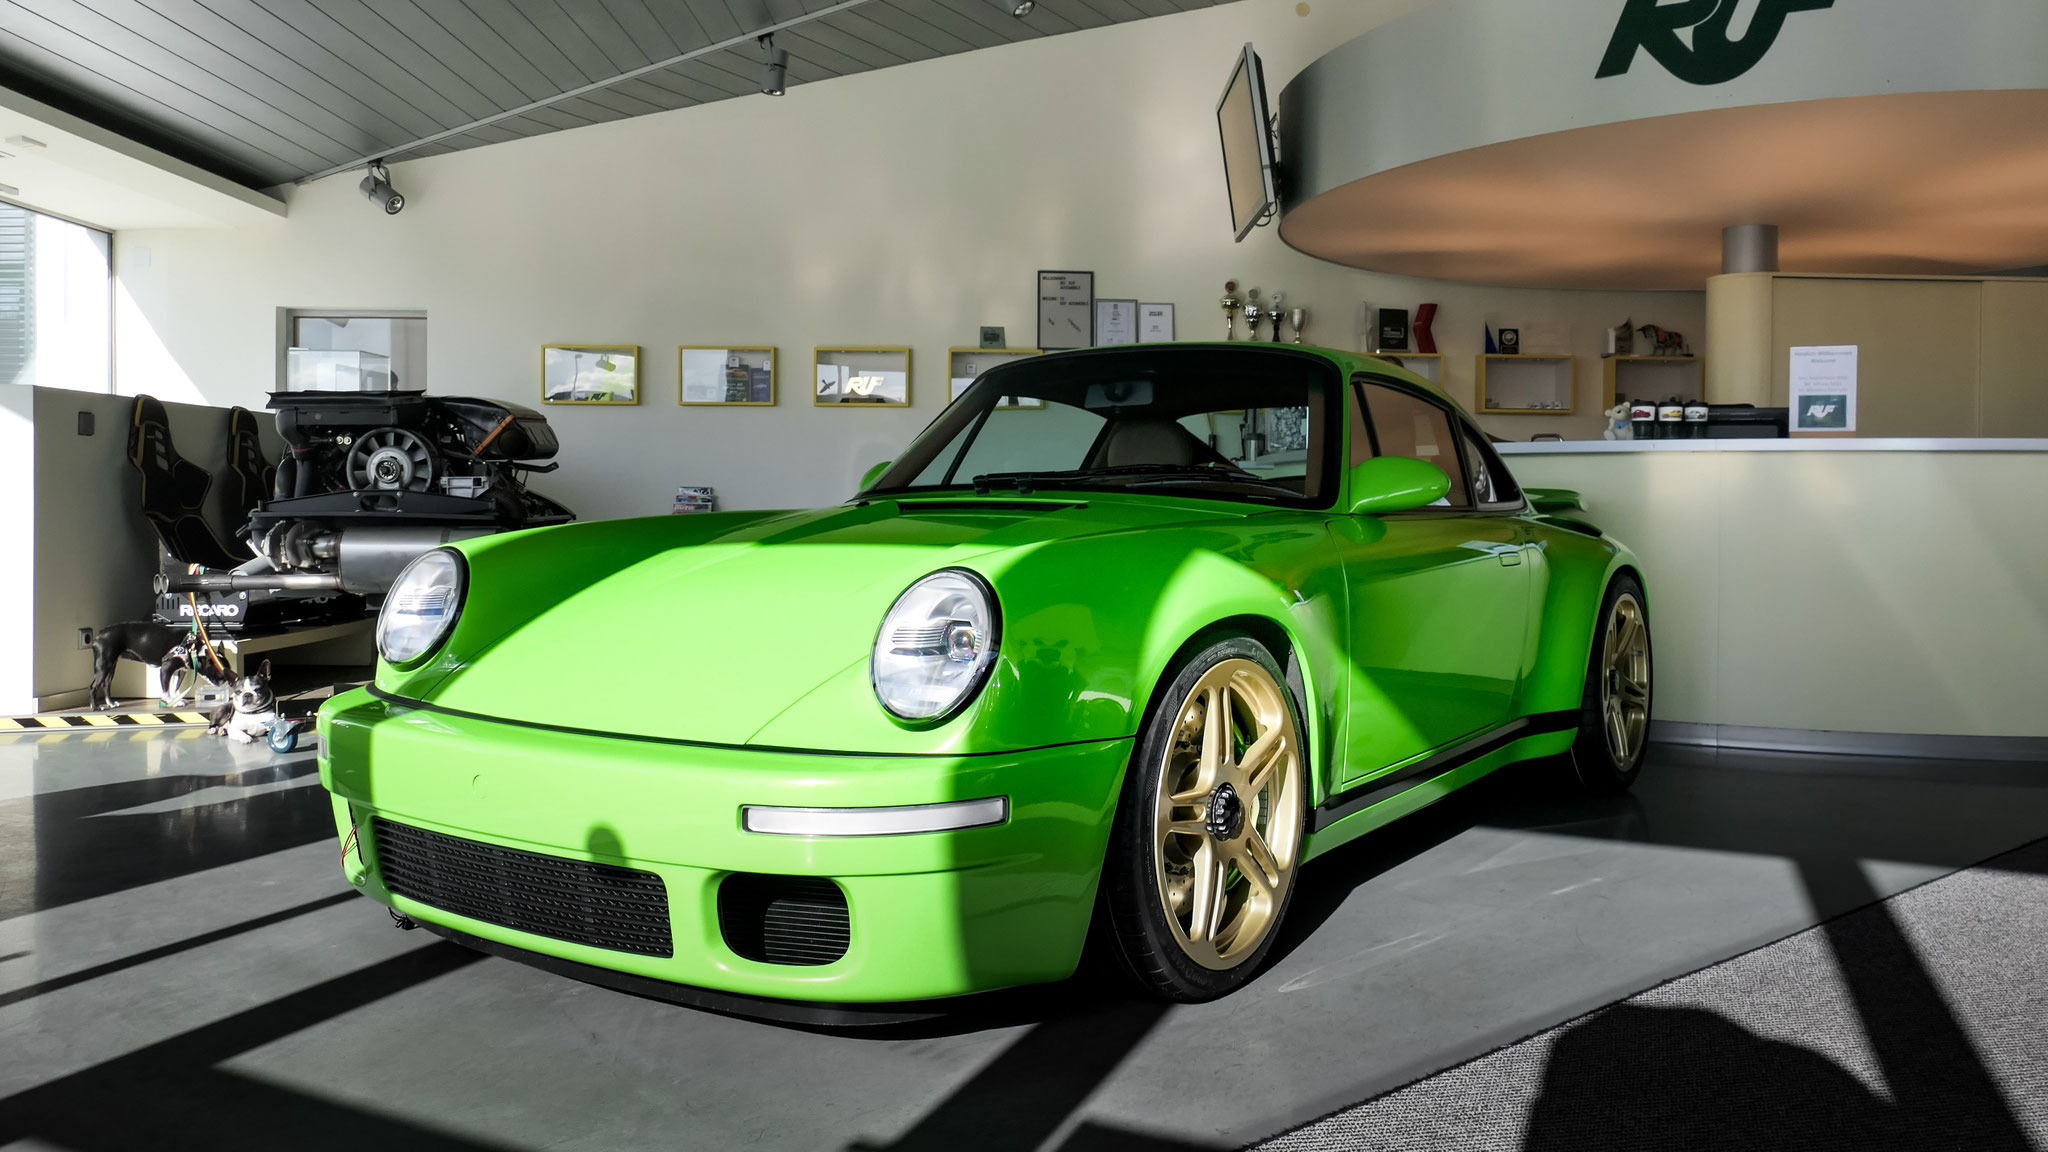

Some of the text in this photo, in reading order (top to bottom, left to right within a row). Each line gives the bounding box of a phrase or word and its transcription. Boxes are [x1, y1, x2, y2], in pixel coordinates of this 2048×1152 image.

[844, 376, 884, 396] RUF
[1806, 405, 1837, 418] RUF
[180, 604, 240, 617] RECARO
